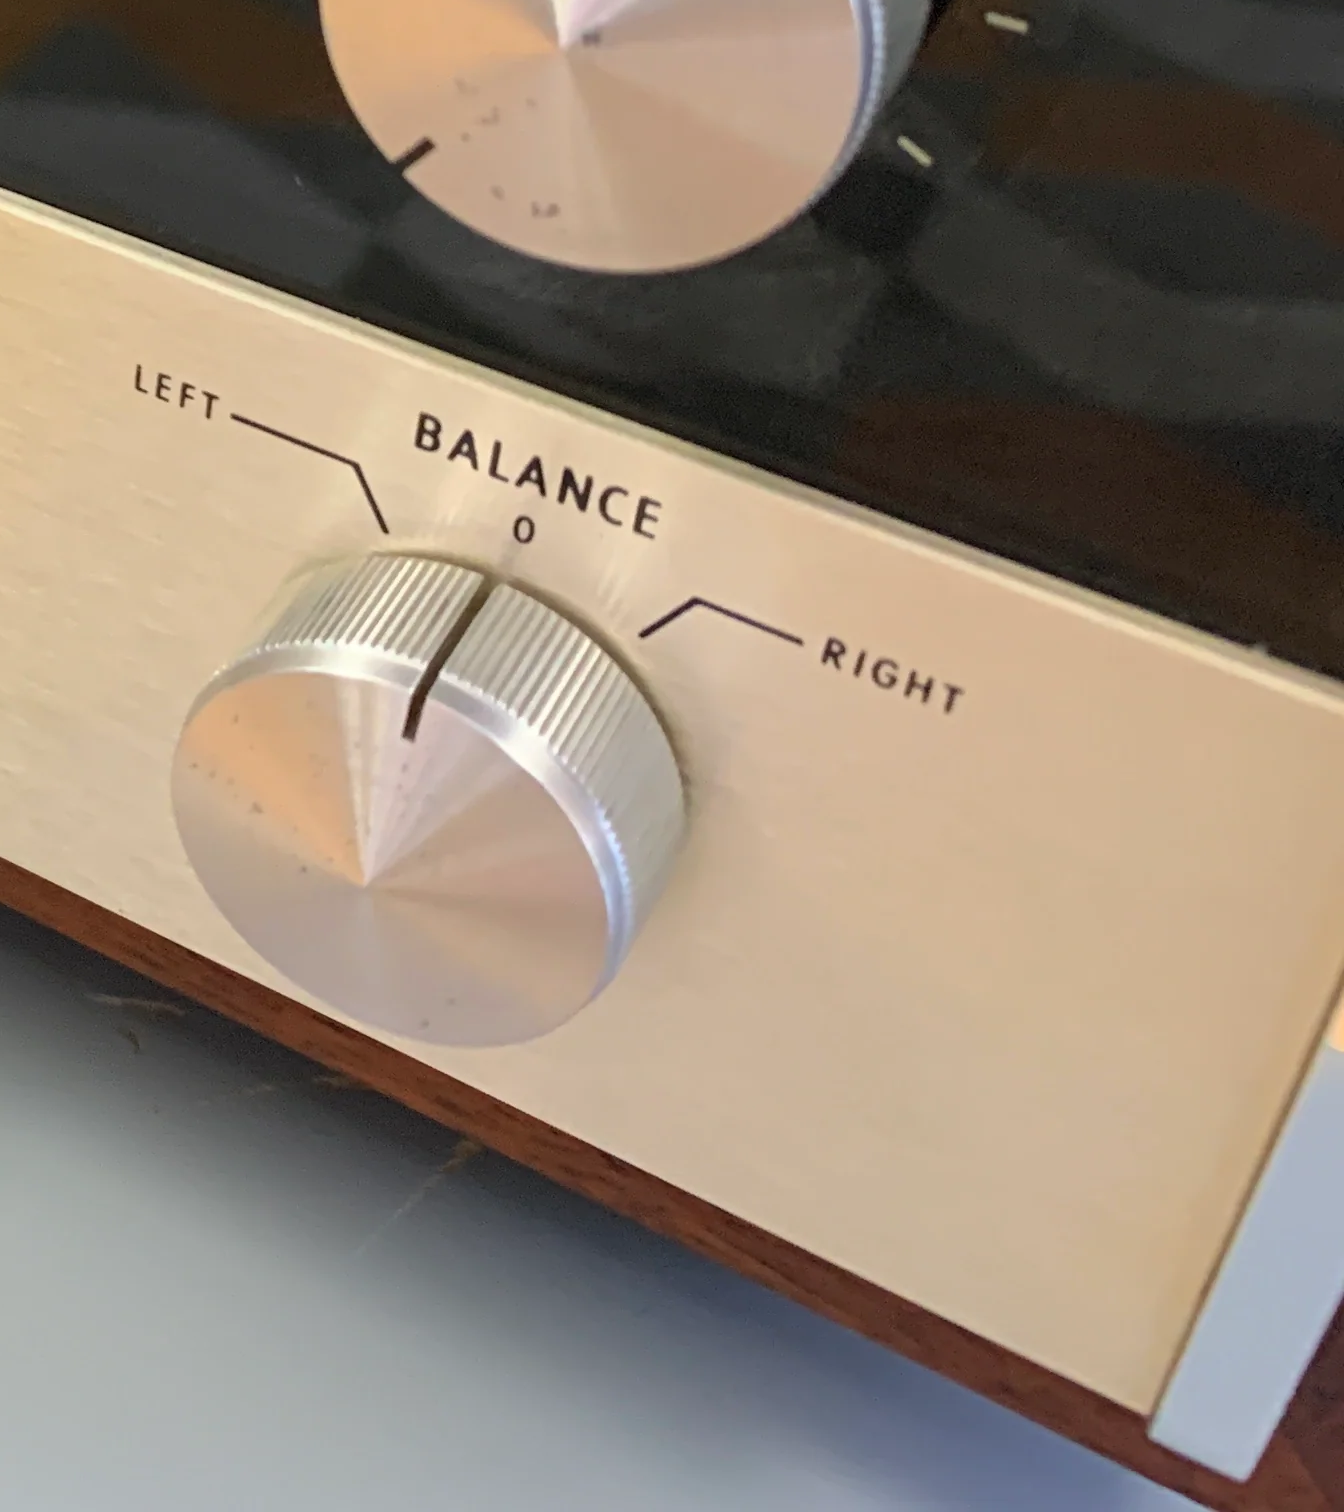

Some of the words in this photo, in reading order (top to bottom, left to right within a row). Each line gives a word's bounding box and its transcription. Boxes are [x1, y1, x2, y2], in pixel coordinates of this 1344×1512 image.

[133, 363, 221, 420] LEFT
[412, 410, 663, 540] BALANCE
[819, 636, 966, 716] RIGHT
